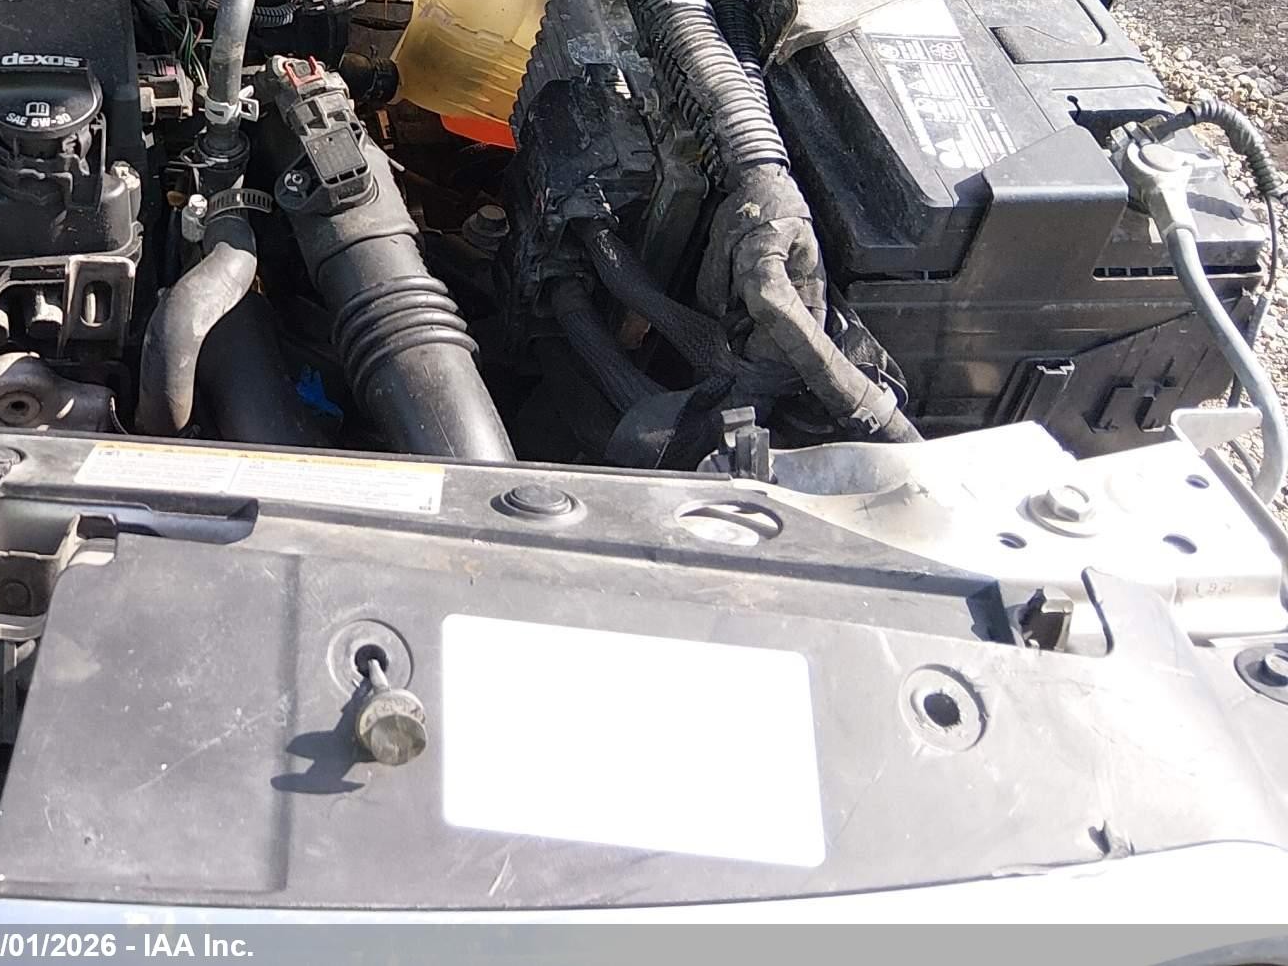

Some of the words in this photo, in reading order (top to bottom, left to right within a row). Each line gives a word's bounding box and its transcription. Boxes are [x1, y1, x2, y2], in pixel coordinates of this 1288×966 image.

[1, 52, 81, 67] dexos
[6, 113, 28, 126] SAE
[31, 113, 72, 127] 5W-30
